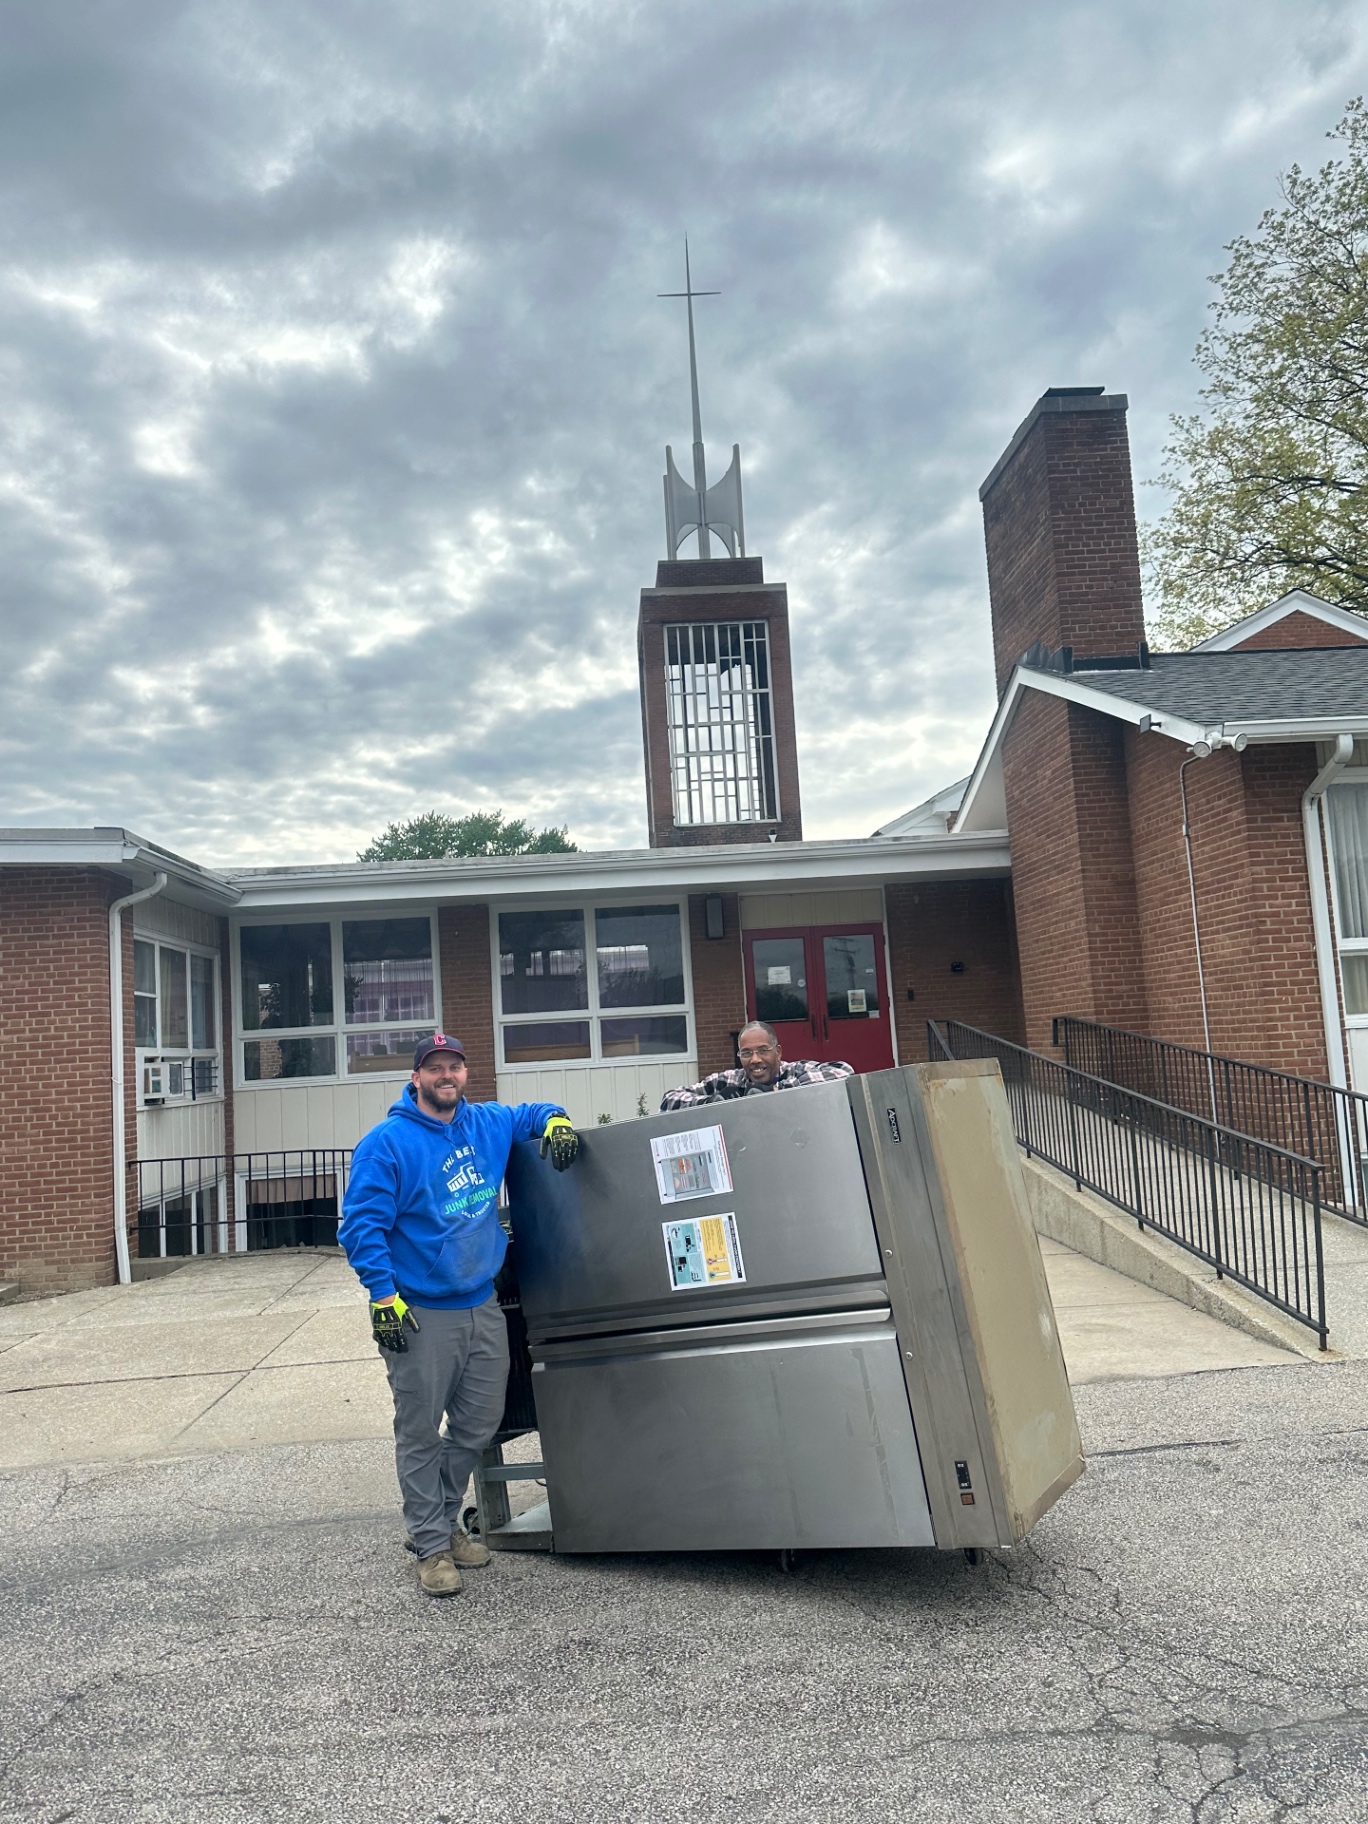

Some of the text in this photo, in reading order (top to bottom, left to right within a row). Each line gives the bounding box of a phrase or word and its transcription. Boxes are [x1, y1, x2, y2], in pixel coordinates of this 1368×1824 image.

[433, 1033, 447, 1046] C
[455, 1145, 476, 1159] BET
[445, 1196, 469, 1215] JUNK
